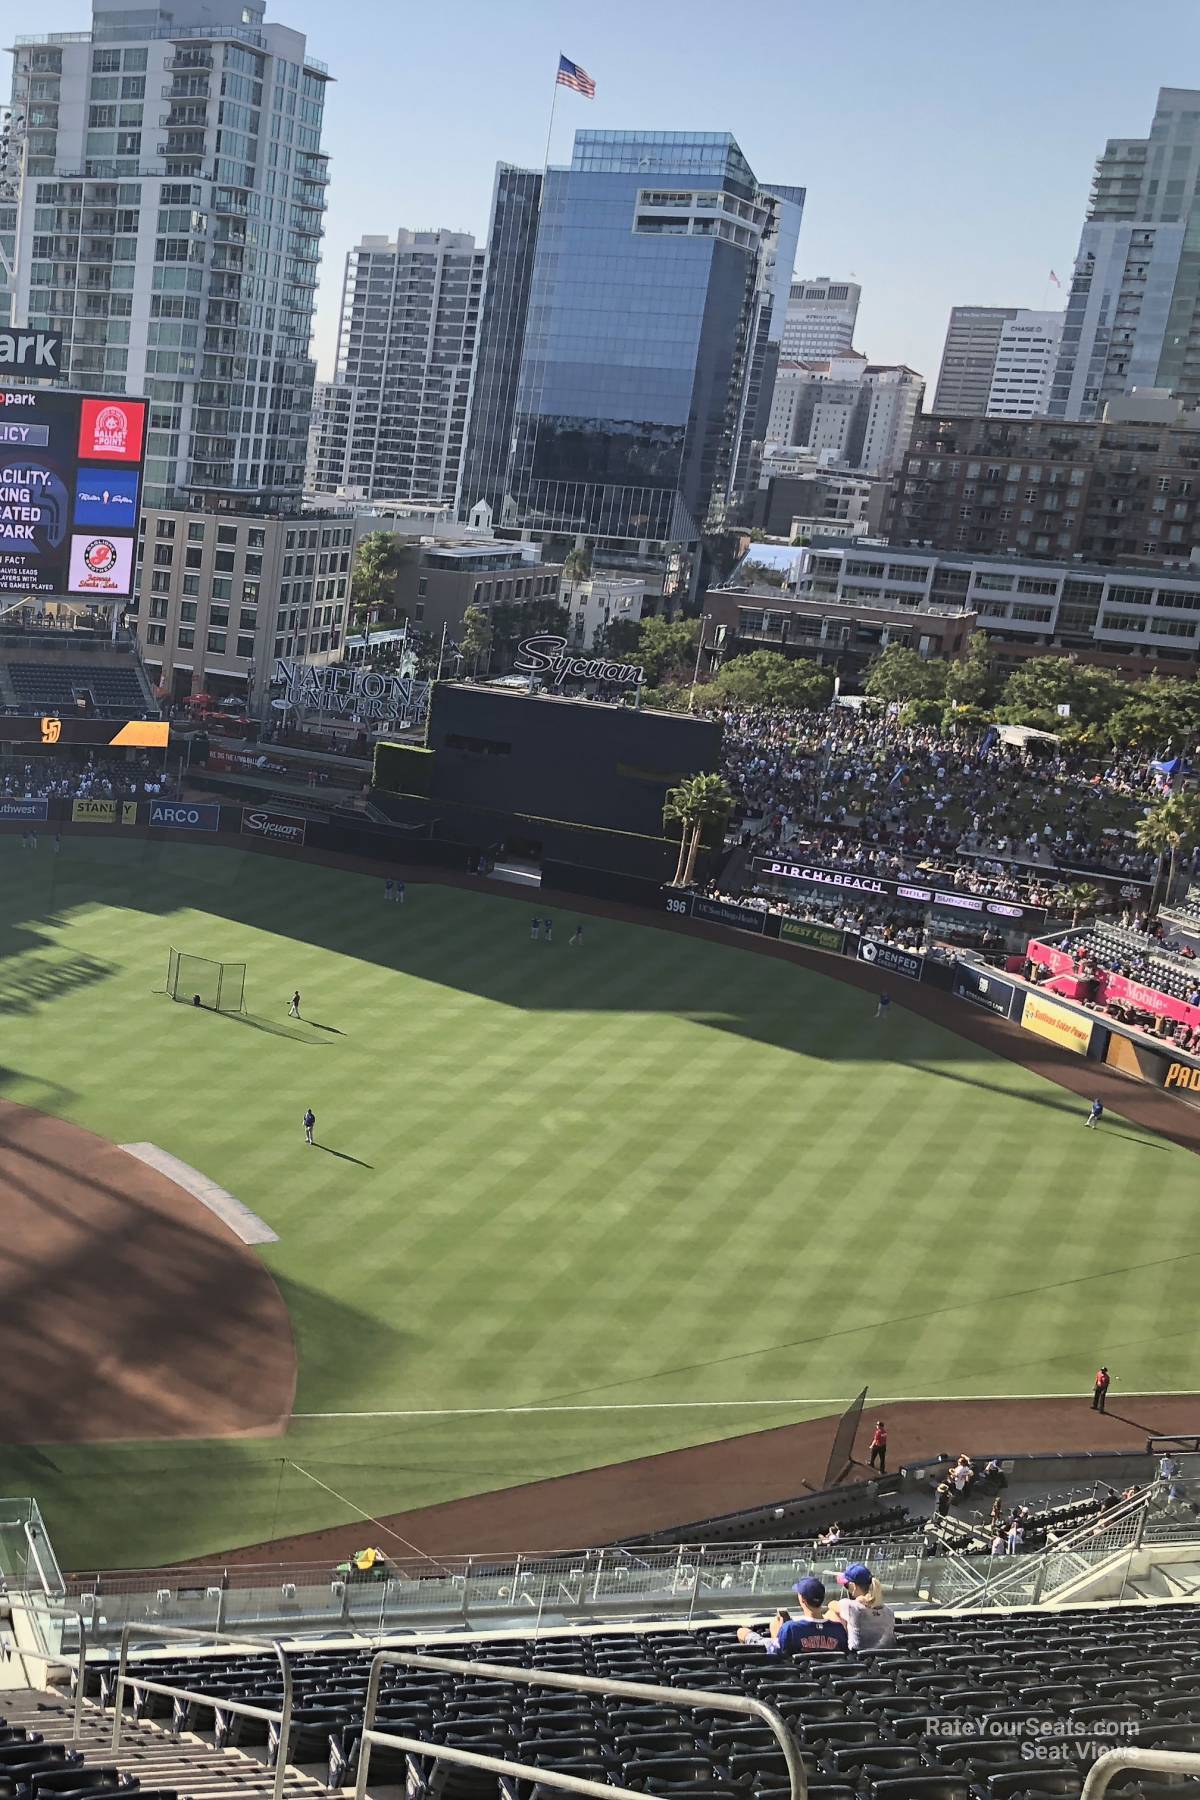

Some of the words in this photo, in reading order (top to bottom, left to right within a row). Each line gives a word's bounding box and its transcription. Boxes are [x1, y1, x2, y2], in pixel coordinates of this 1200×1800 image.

[93, 427, 127, 439] BALLAST
[4, 556, 26, 565] FACT
[513, 635, 648, 686] Sycuan
[152, 807, 199, 824] ARCO
[243, 813, 298, 836] Sycuan
[772, 863, 822, 881] PIRCH
[834, 874, 883, 892] BEACH
[666, 899, 686, 913] 396
[879, 950, 917, 969] PENFED
[1056, 1019, 1071, 1032] Solar
[1071, 1026, 1089, 1041] Power
